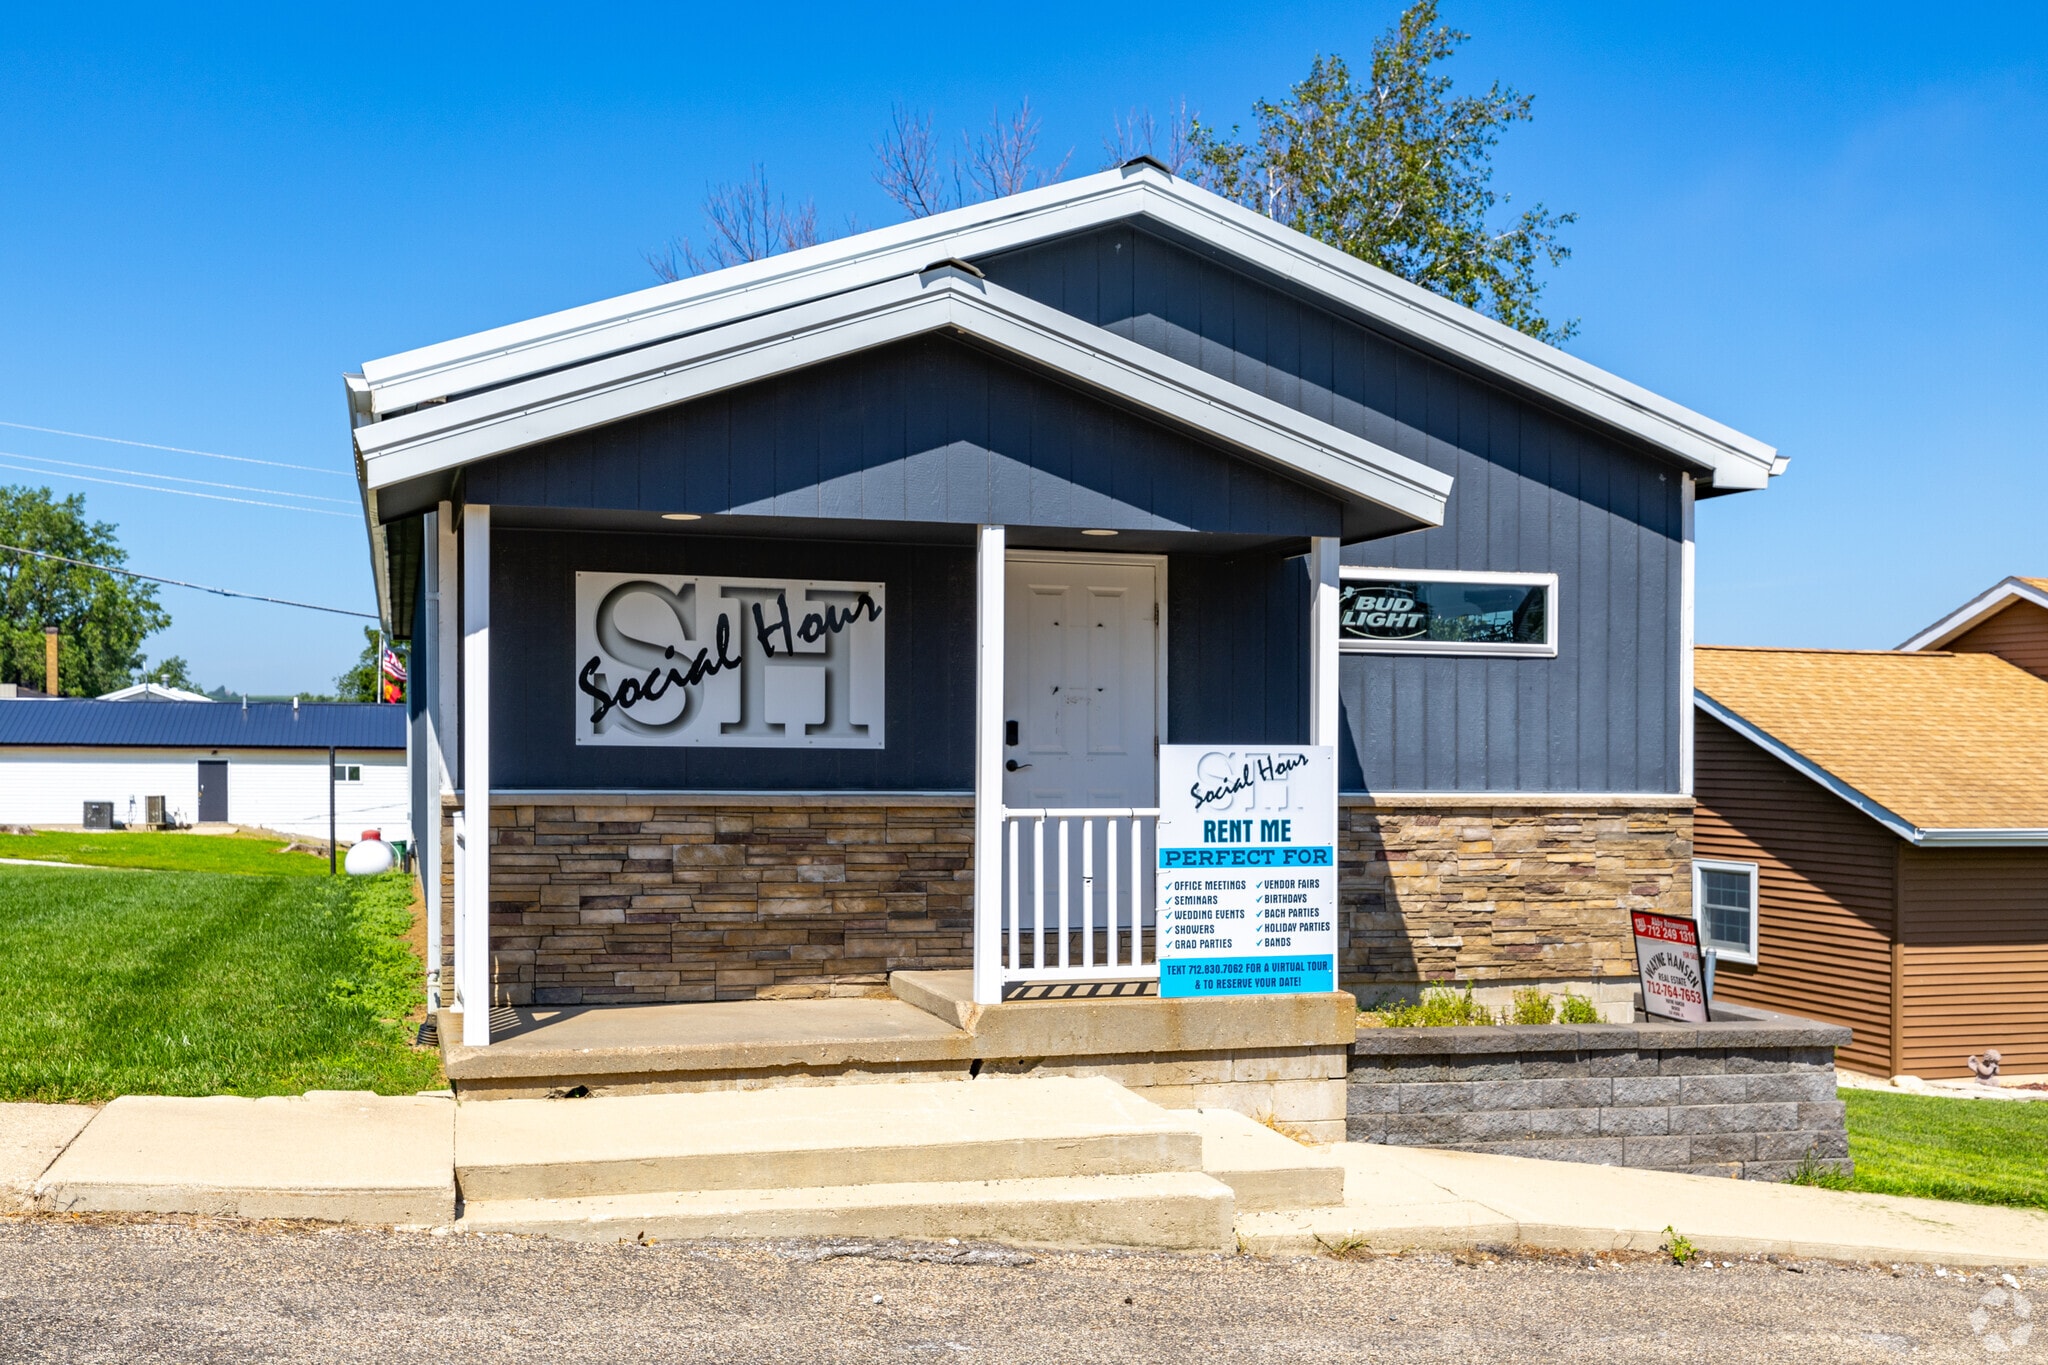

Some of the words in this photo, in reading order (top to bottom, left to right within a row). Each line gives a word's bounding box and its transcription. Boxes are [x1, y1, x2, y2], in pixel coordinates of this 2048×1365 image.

[1355, 596, 1414, 612] BUD
[1341, 611, 1424, 628] LIGHT
[578, 613, 742, 724] Social
[752, 593, 883, 658] Hour
[594, 580, 869, 738] SH
[1190, 764, 1254, 809] Social
[1258, 753, 1309, 781] Hour
[1203, 819, 1253, 843] RENT
[1260, 819, 1291, 843] ME
[1165, 850, 1275, 866] PERFECT
[1283, 849, 1328, 865] FOR
[1174, 881, 1202, 890] OFFICE
[1205, 880, 1246, 890] MEETINGS
[1264, 879, 1295, 889] VENDOR
[1298, 879, 1320, 889] FAIRS
[1174, 895, 1218, 905] SEMINARS
[1264, 893, 1307, 904] BIRTHDAYS
[1174, 910, 1213, 920] WEDDING
[1215, 909, 1245, 919] EVENTS
[1264, 908, 1286, 918] BACH
[1288, 907, 1320, 918] PARTIES
[1174, 924, 1215, 934] SHOWERS
[1264, 923, 1297, 933] HOLIDAY
[1299, 922, 1331, 932] PARTIES
[1647, 925, 1661, 937] 712
[1662, 928, 1677, 940] 249
[1679, 931, 1696, 943] 1311
[1175, 939, 1197, 949] GRAD
[1199, 938, 1233, 949] PARTIES
[1264, 937, 1291, 947] BANDS
[1167, 965, 1186, 975] TEXT
[1188, 963, 1243, 975] 712.830.7062
[1246, 963, 1261, 973] FOR
[1264, 963, 1270, 973] A
[1272, 961, 1305, 972] VIRTUAL
[1307, 961, 1328, 971] TOUR
[1645, 952, 1666, 979] WAYNE
[1667, 952, 1700, 989] HANSEN
[1195, 980, 1201, 990] &
[1203, 979, 1213, 989] TO
[1216, 978, 1252, 989] RESERVE
[1255, 977, 1276, 988] YOUR
[1279, 977, 1302, 987] DATE!
[1658, 972, 1670, 982] REAL
[1670, 975, 1687, 987] ESTATE
[1646, 980, 1702, 1004] 712-764-7653
